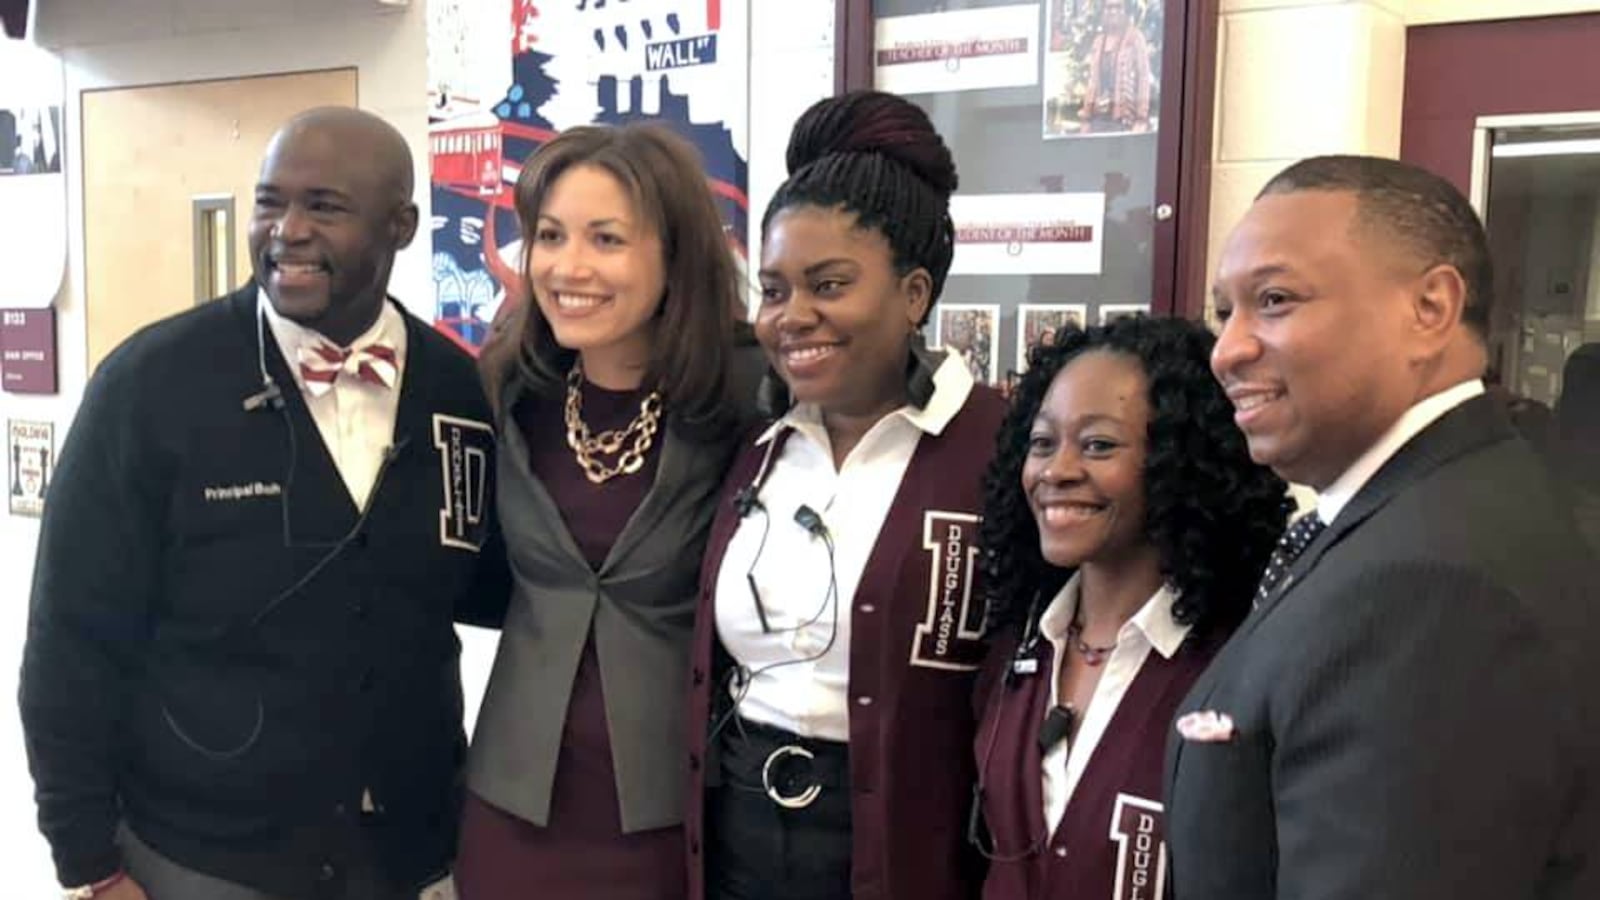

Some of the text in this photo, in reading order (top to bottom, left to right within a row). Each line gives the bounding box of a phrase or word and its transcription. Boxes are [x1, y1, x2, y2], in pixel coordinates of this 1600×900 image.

[647, 41, 700, 69] WALL
[957, 228, 995, 241] UDENT
[1037, 226, 1085, 240] MONTH
[935, 524, 961, 655] DOUGLASS
